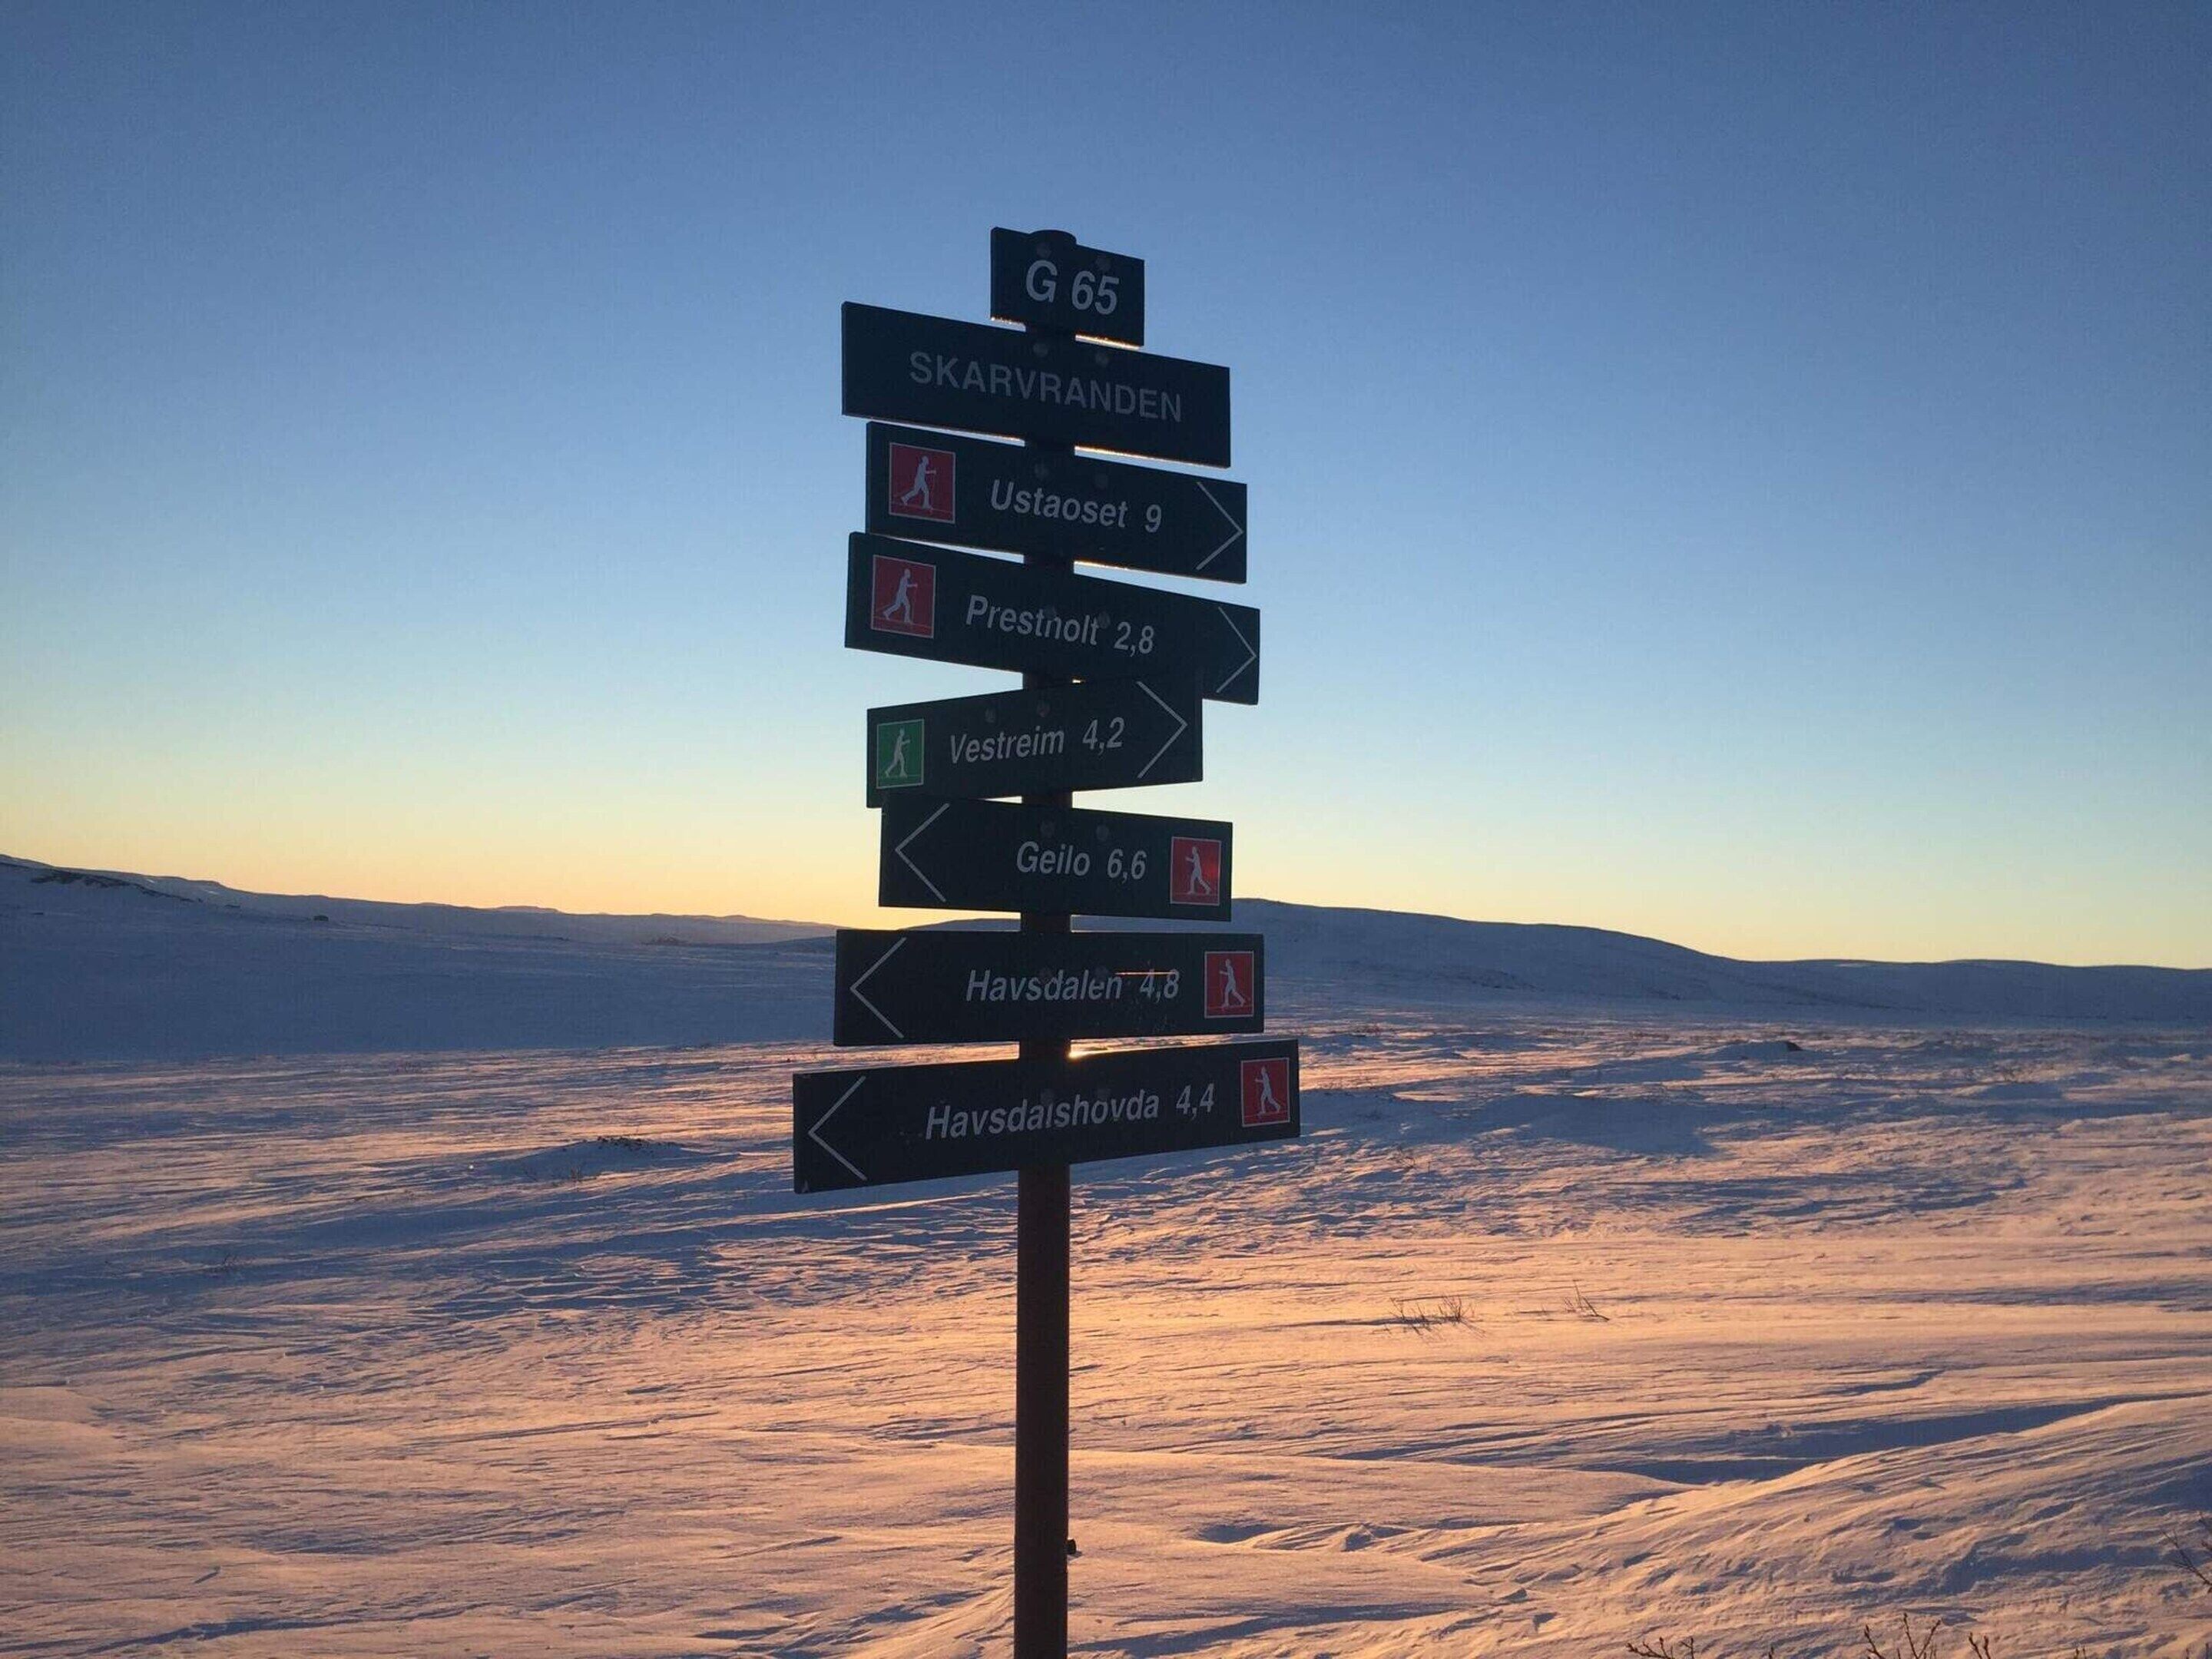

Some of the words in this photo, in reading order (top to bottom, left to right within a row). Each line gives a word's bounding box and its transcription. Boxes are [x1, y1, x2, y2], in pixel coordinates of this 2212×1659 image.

[1025, 260, 1058, 303] G
[1071, 270, 1121, 316] 65
[909, 350, 1182, 423] SKARVRANDEN
[991, 479, 1128, 528] Ustaoset
[1144, 504, 1163, 534] 9
[1114, 621, 1155, 657] 2,8
[950, 725, 1065, 764] Vestreim
[1082, 717, 1125, 755] 4,2
[1016, 841, 1091, 877] Geilo
[1108, 849, 1148, 882] 6,6
[966, 969, 1123, 1002] Havsdalen
[1139, 969, 1180, 1003] 4,8
[1176, 1083, 1214, 1120] 4,4
